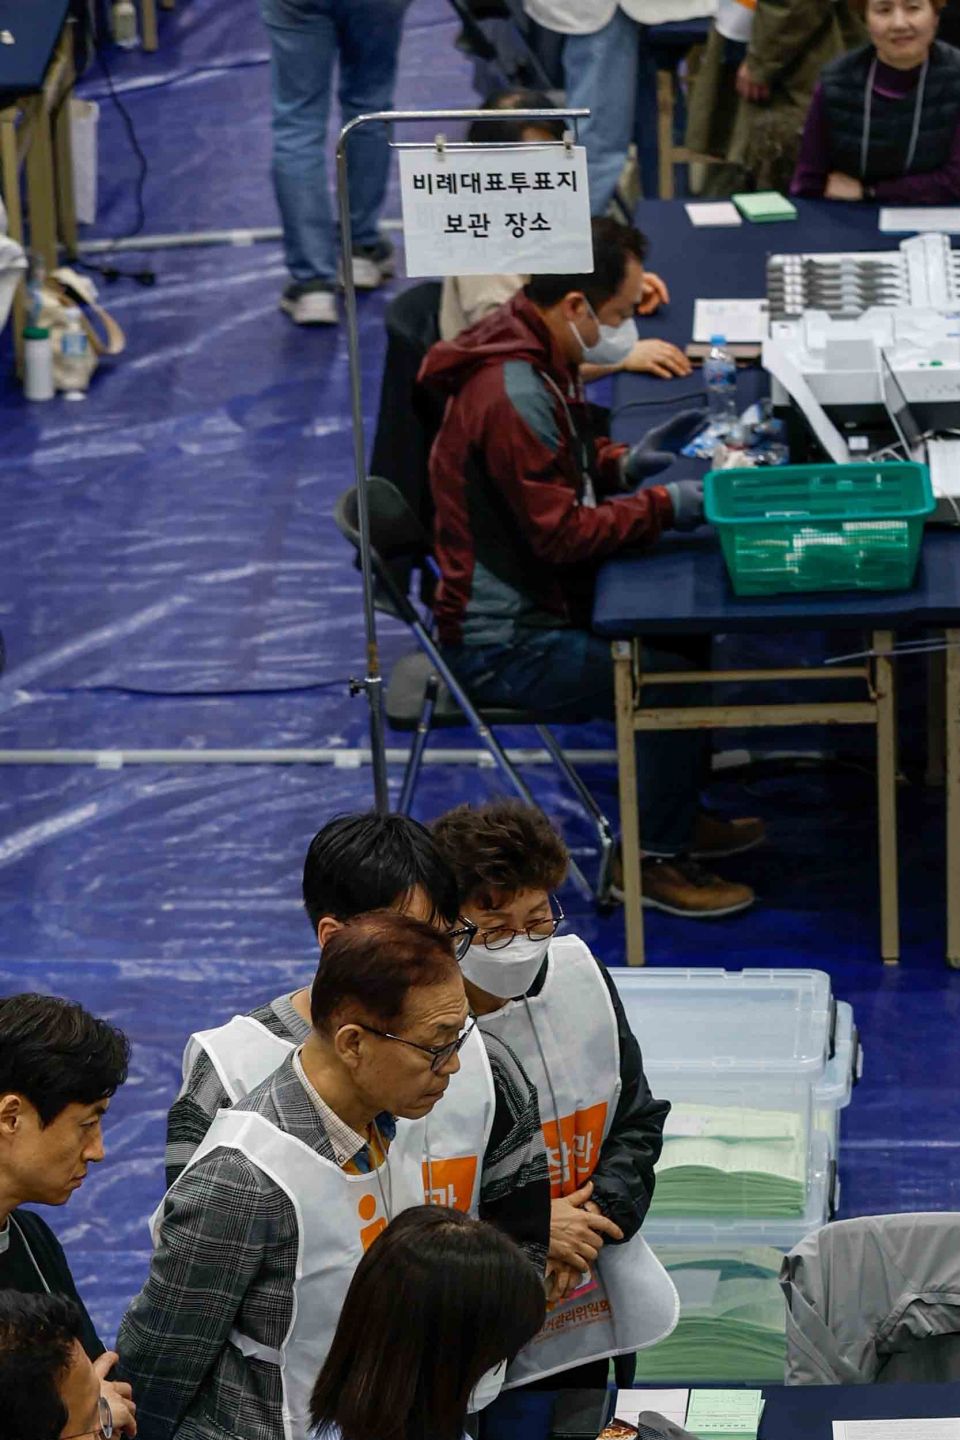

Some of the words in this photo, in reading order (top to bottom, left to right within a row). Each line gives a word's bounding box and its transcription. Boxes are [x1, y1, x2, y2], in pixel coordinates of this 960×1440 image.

[413, 170, 578, 195] 비례대표투표지
[444, 213, 491, 238] 보관
[505, 212, 552, 238] 장소
